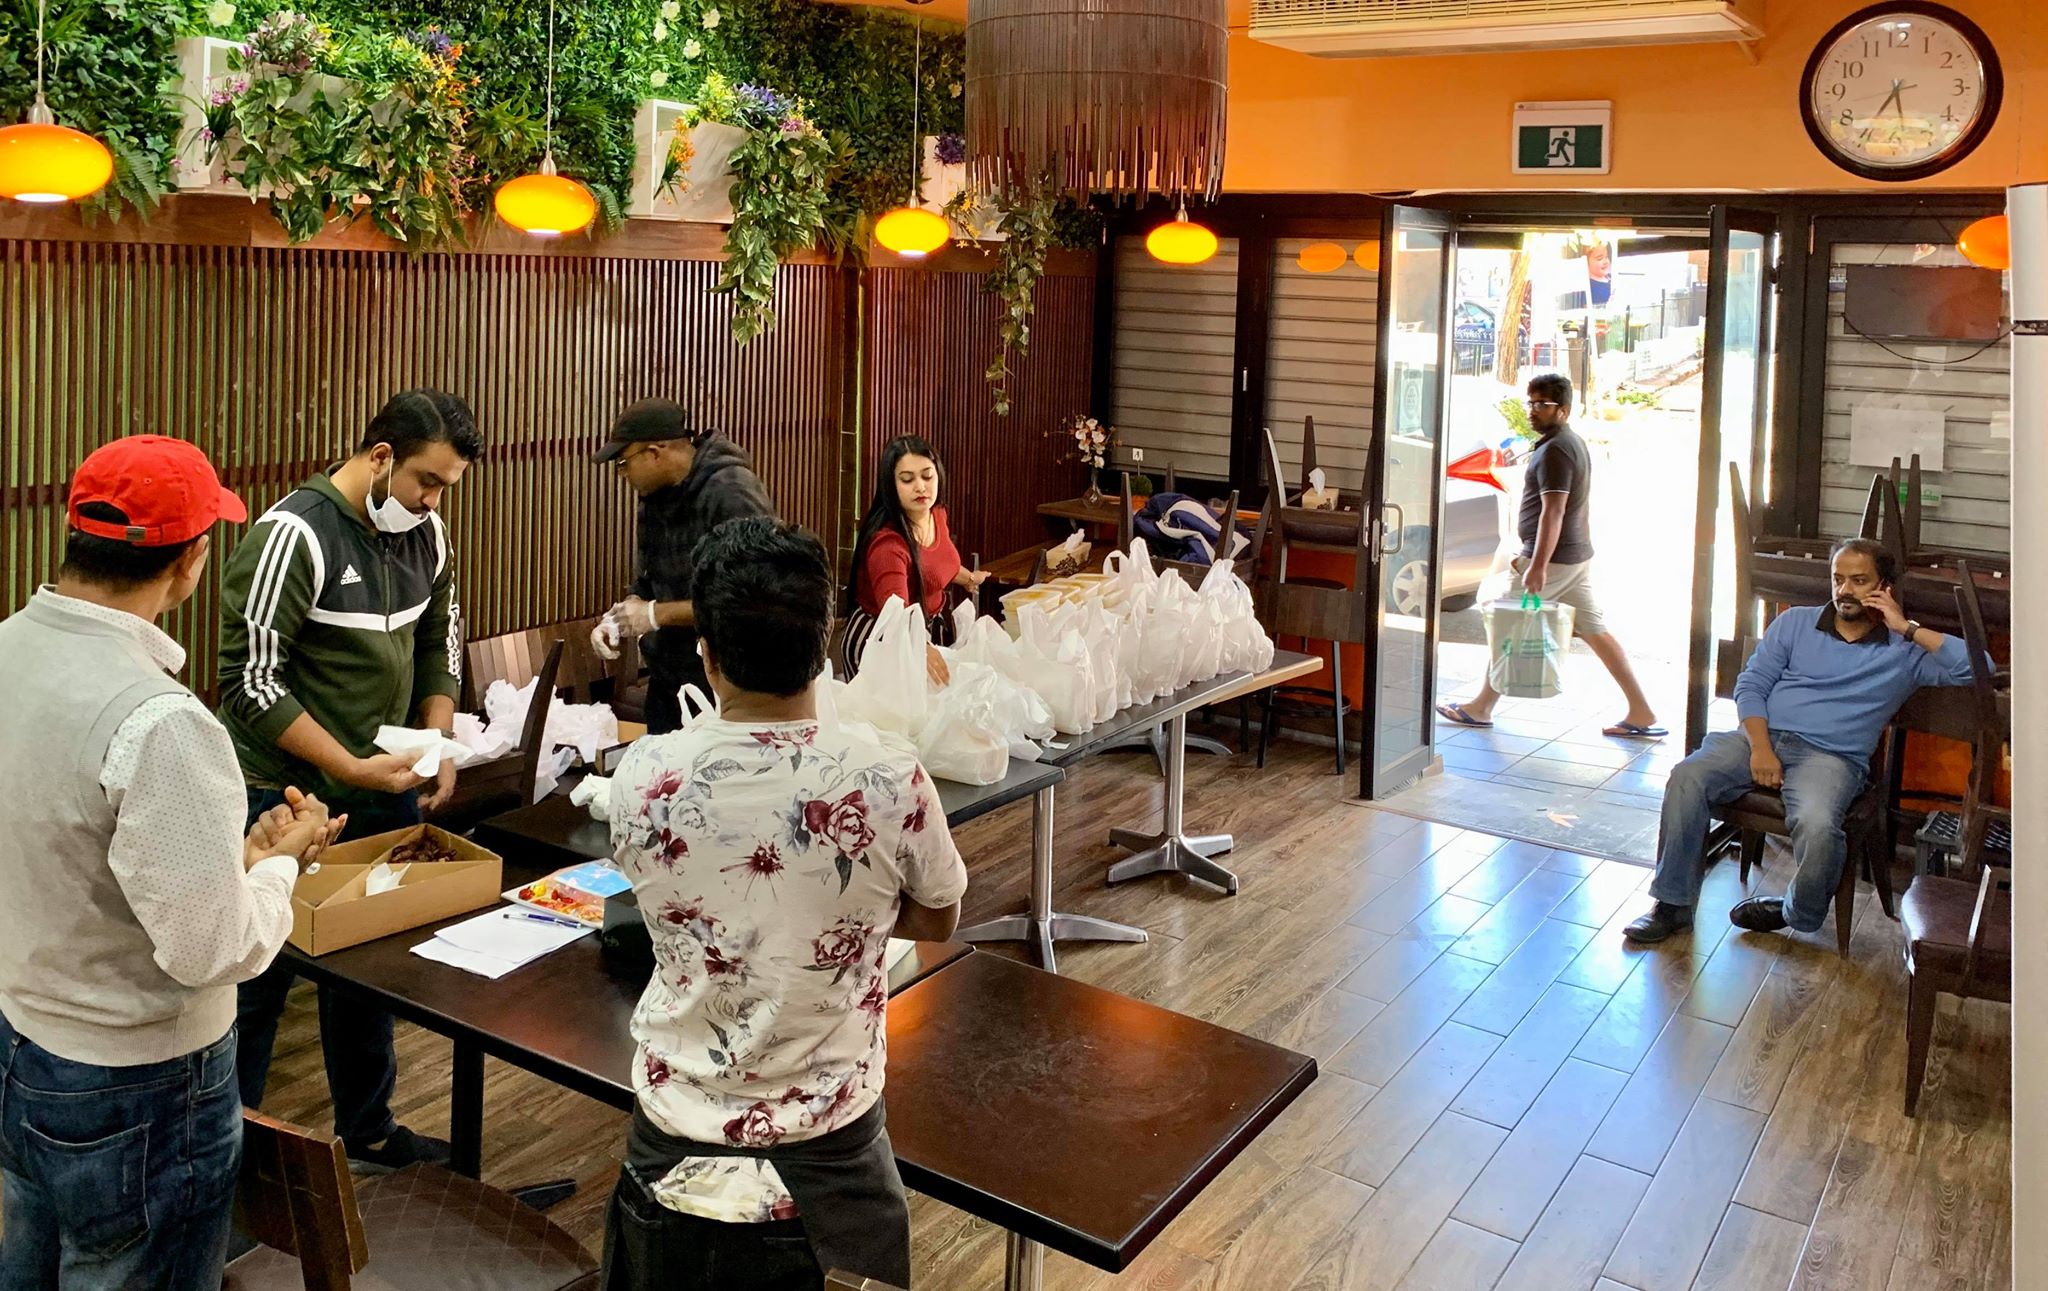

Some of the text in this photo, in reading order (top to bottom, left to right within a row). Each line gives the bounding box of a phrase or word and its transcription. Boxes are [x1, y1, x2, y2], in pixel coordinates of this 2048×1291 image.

[1888, 31, 1909, 48] 12
[1924, 36, 1929, 54] 1
[1864, 41, 1879, 58] 11
[1940, 51, 1953, 69] 2
[1842, 60, 1864, 79] 10
[1832, 82, 1846, 101] 9
[1952, 78, 1965, 97] 3
[1840, 108, 1854, 126] 8
[1940, 104, 1954, 121] 4
